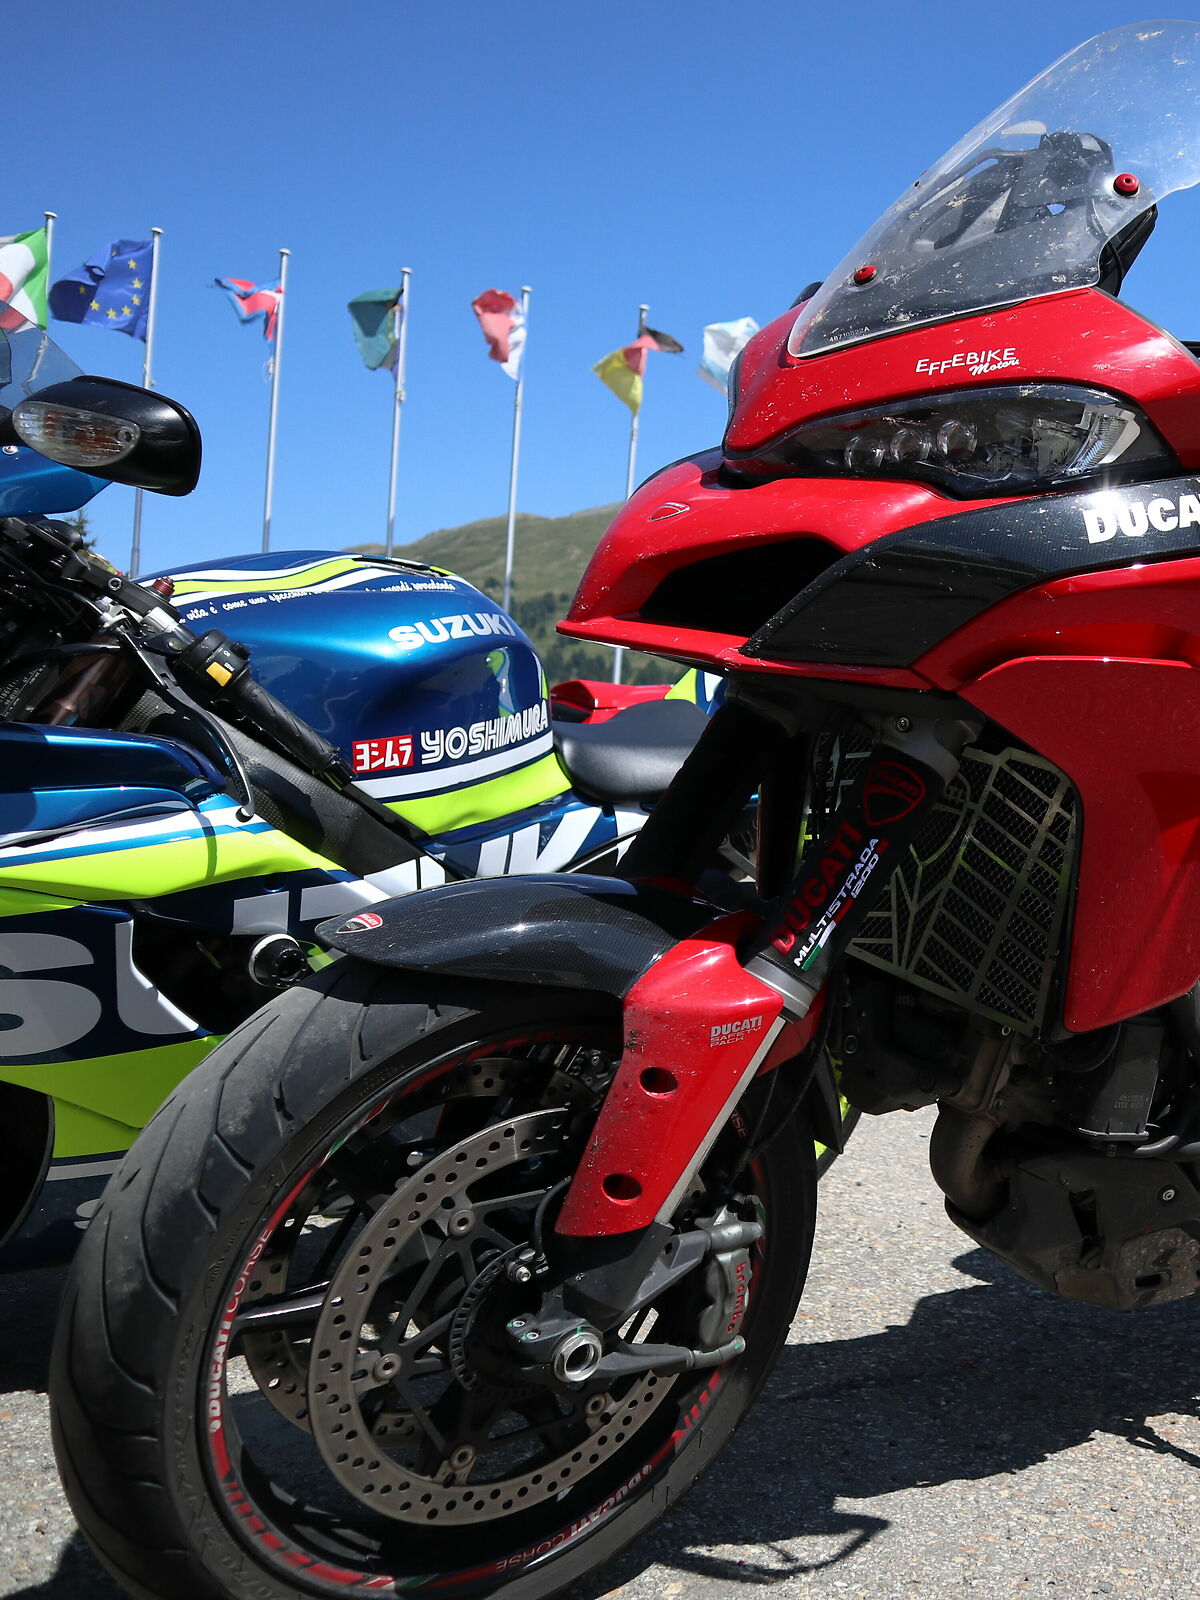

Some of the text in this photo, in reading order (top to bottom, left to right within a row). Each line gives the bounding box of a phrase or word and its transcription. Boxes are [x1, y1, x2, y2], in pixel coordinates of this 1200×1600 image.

[915, 347, 1017, 376] EFFEBIKE
[388, 612, 516, 650] SUZUKI
[355, 738, 412, 771] ヨシムラ
[420, 699, 549, 765] YOSHIMURA
[769, 821, 863, 957] DUCATI
[793, 838, 879, 967] MULTISTRADA
[850, 853, 880, 899] 1200
[710, 1016, 763, 1037] DUCATI
[710, 1026, 762, 1043] SAFETY
[208, 1320, 233, 1416] DUCATI
[226, 1228, 273, 1314] CORSE
[726, 1261, 747, 1333] brembo
[569, 1472, 642, 1538] DUCATI
